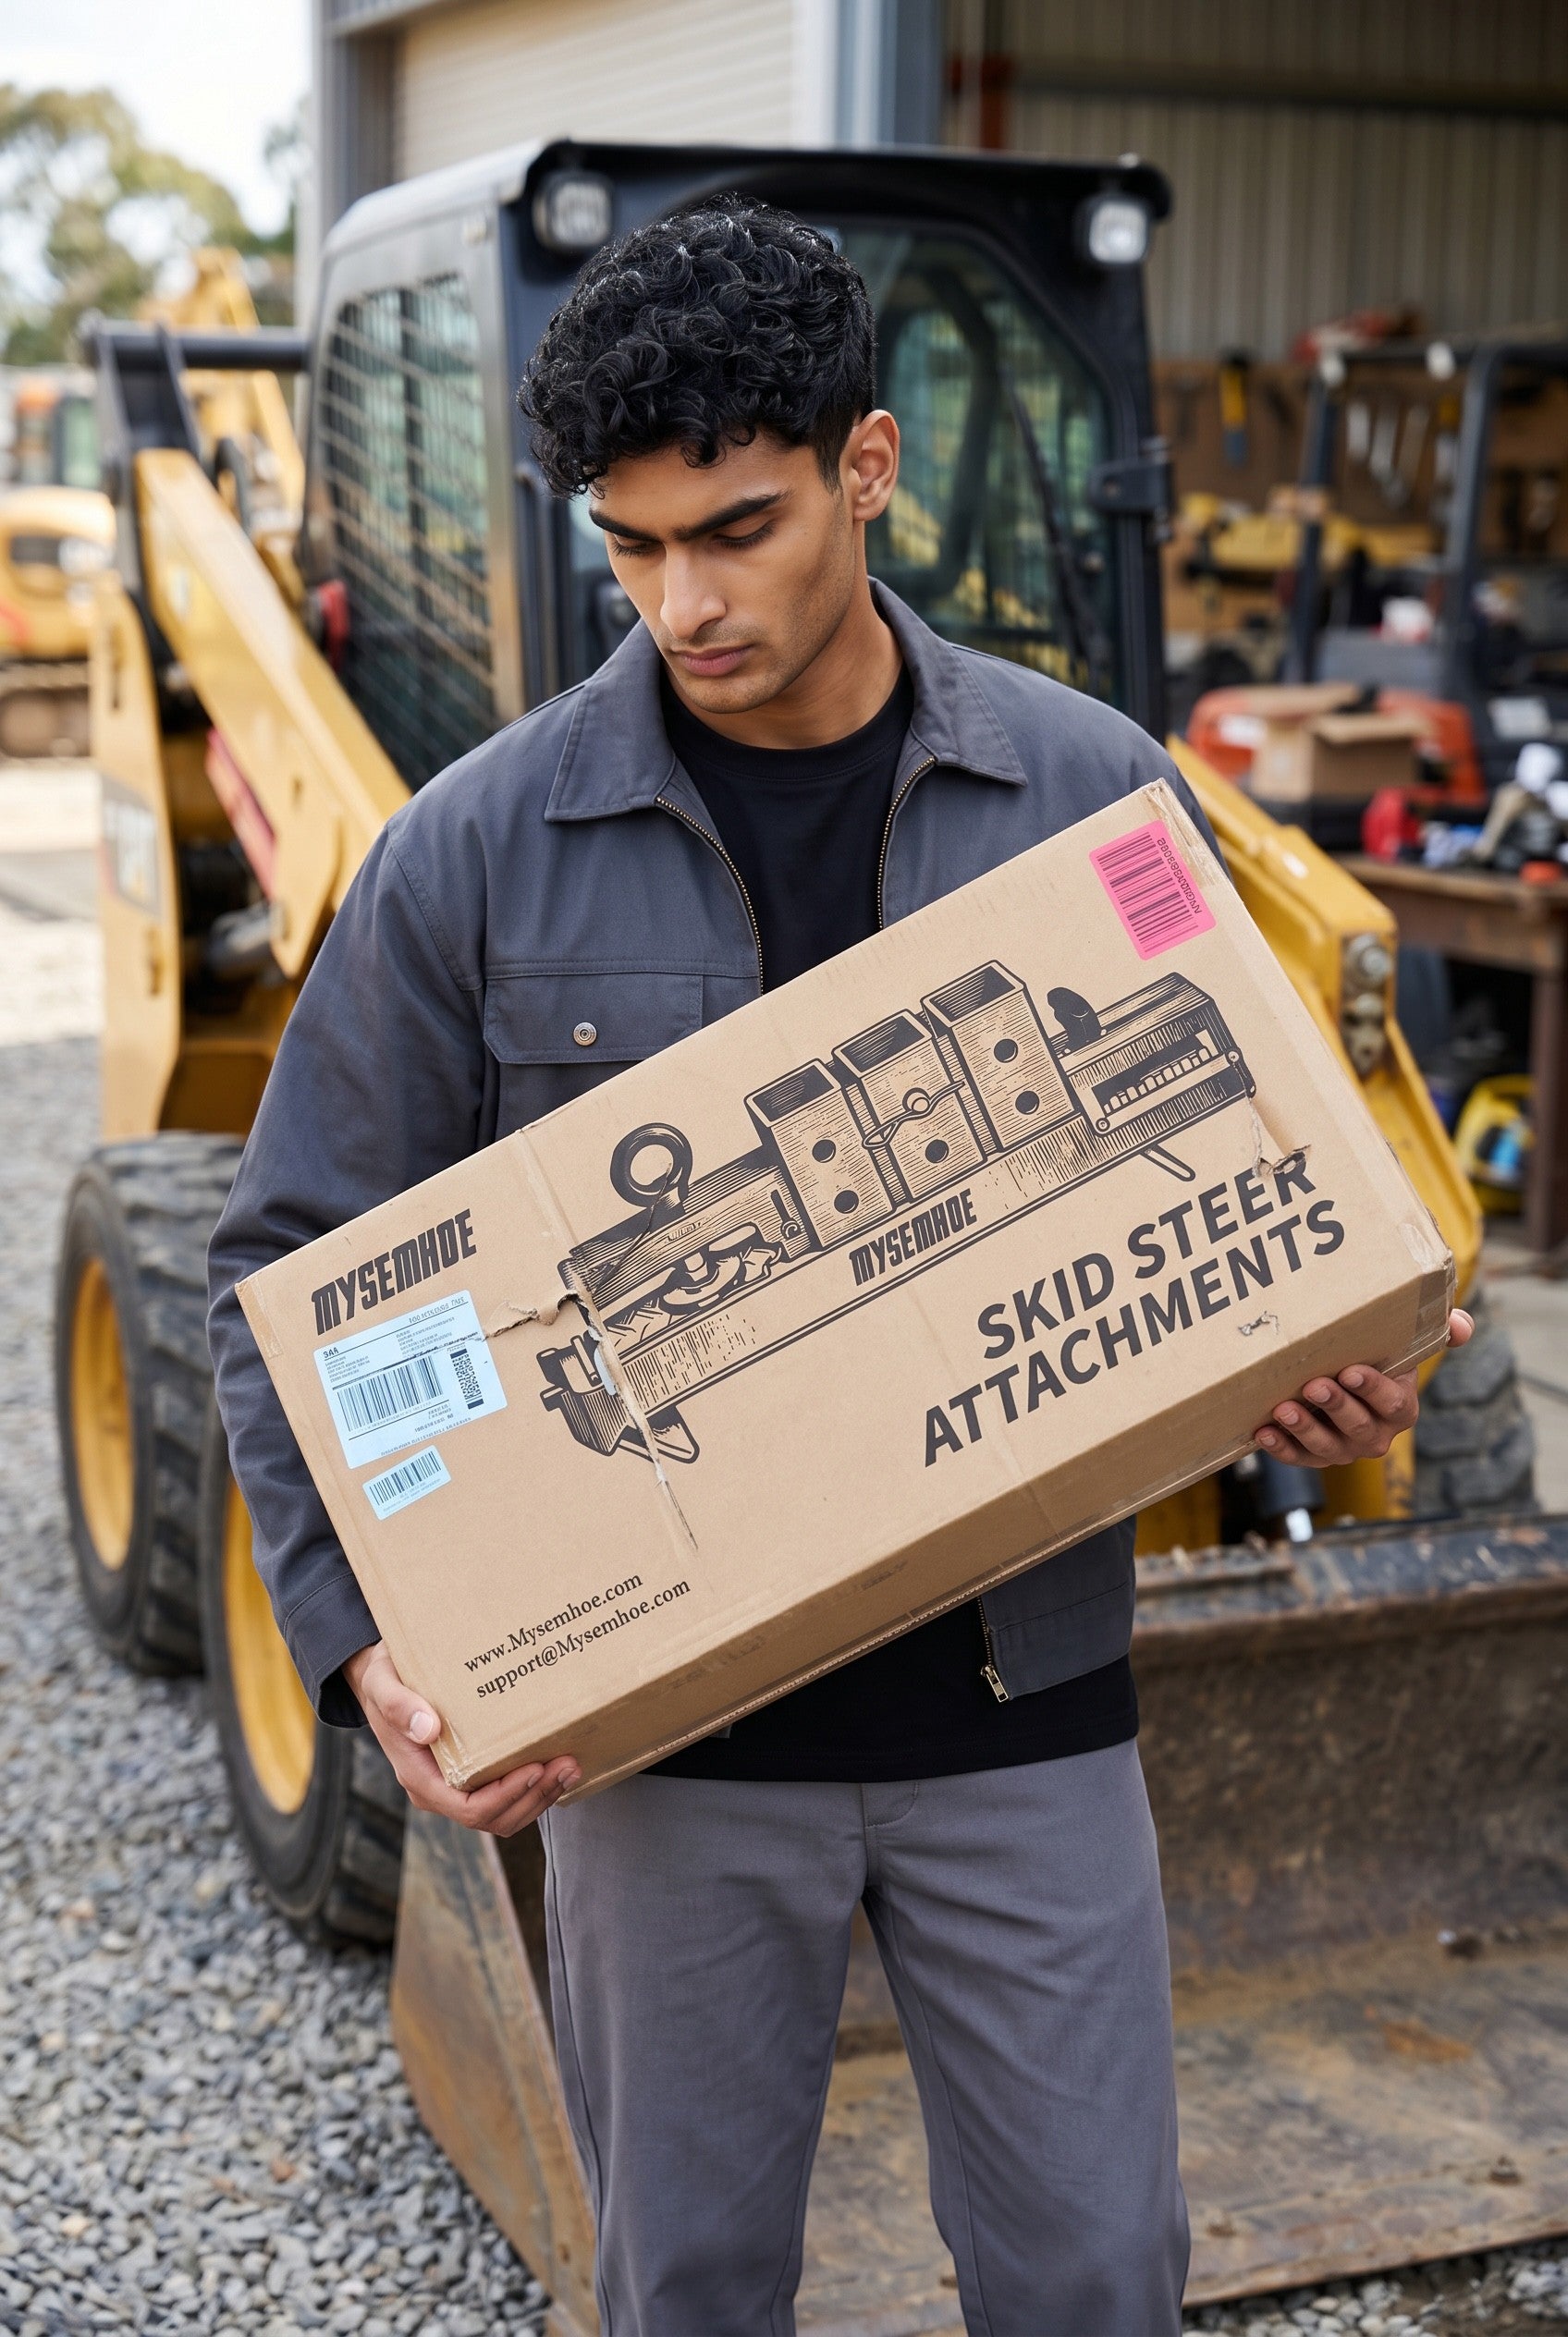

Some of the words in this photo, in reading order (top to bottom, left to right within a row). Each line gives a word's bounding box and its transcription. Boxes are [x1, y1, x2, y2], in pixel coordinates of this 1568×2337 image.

[312, 1208, 477, 1336] MYSEMHOE
[849, 1188, 977, 1286] MYSEMHOE
[977, 1253, 1114, 1359] SKID
[1128, 1151, 1317, 1279] STEER
[925, 1200, 1345, 1467] ATTACHMENTS
[464, 1574, 643, 1672] www.Mysemhoe.com
[476, 1581, 691, 1698] support@Mysemhoe.com
